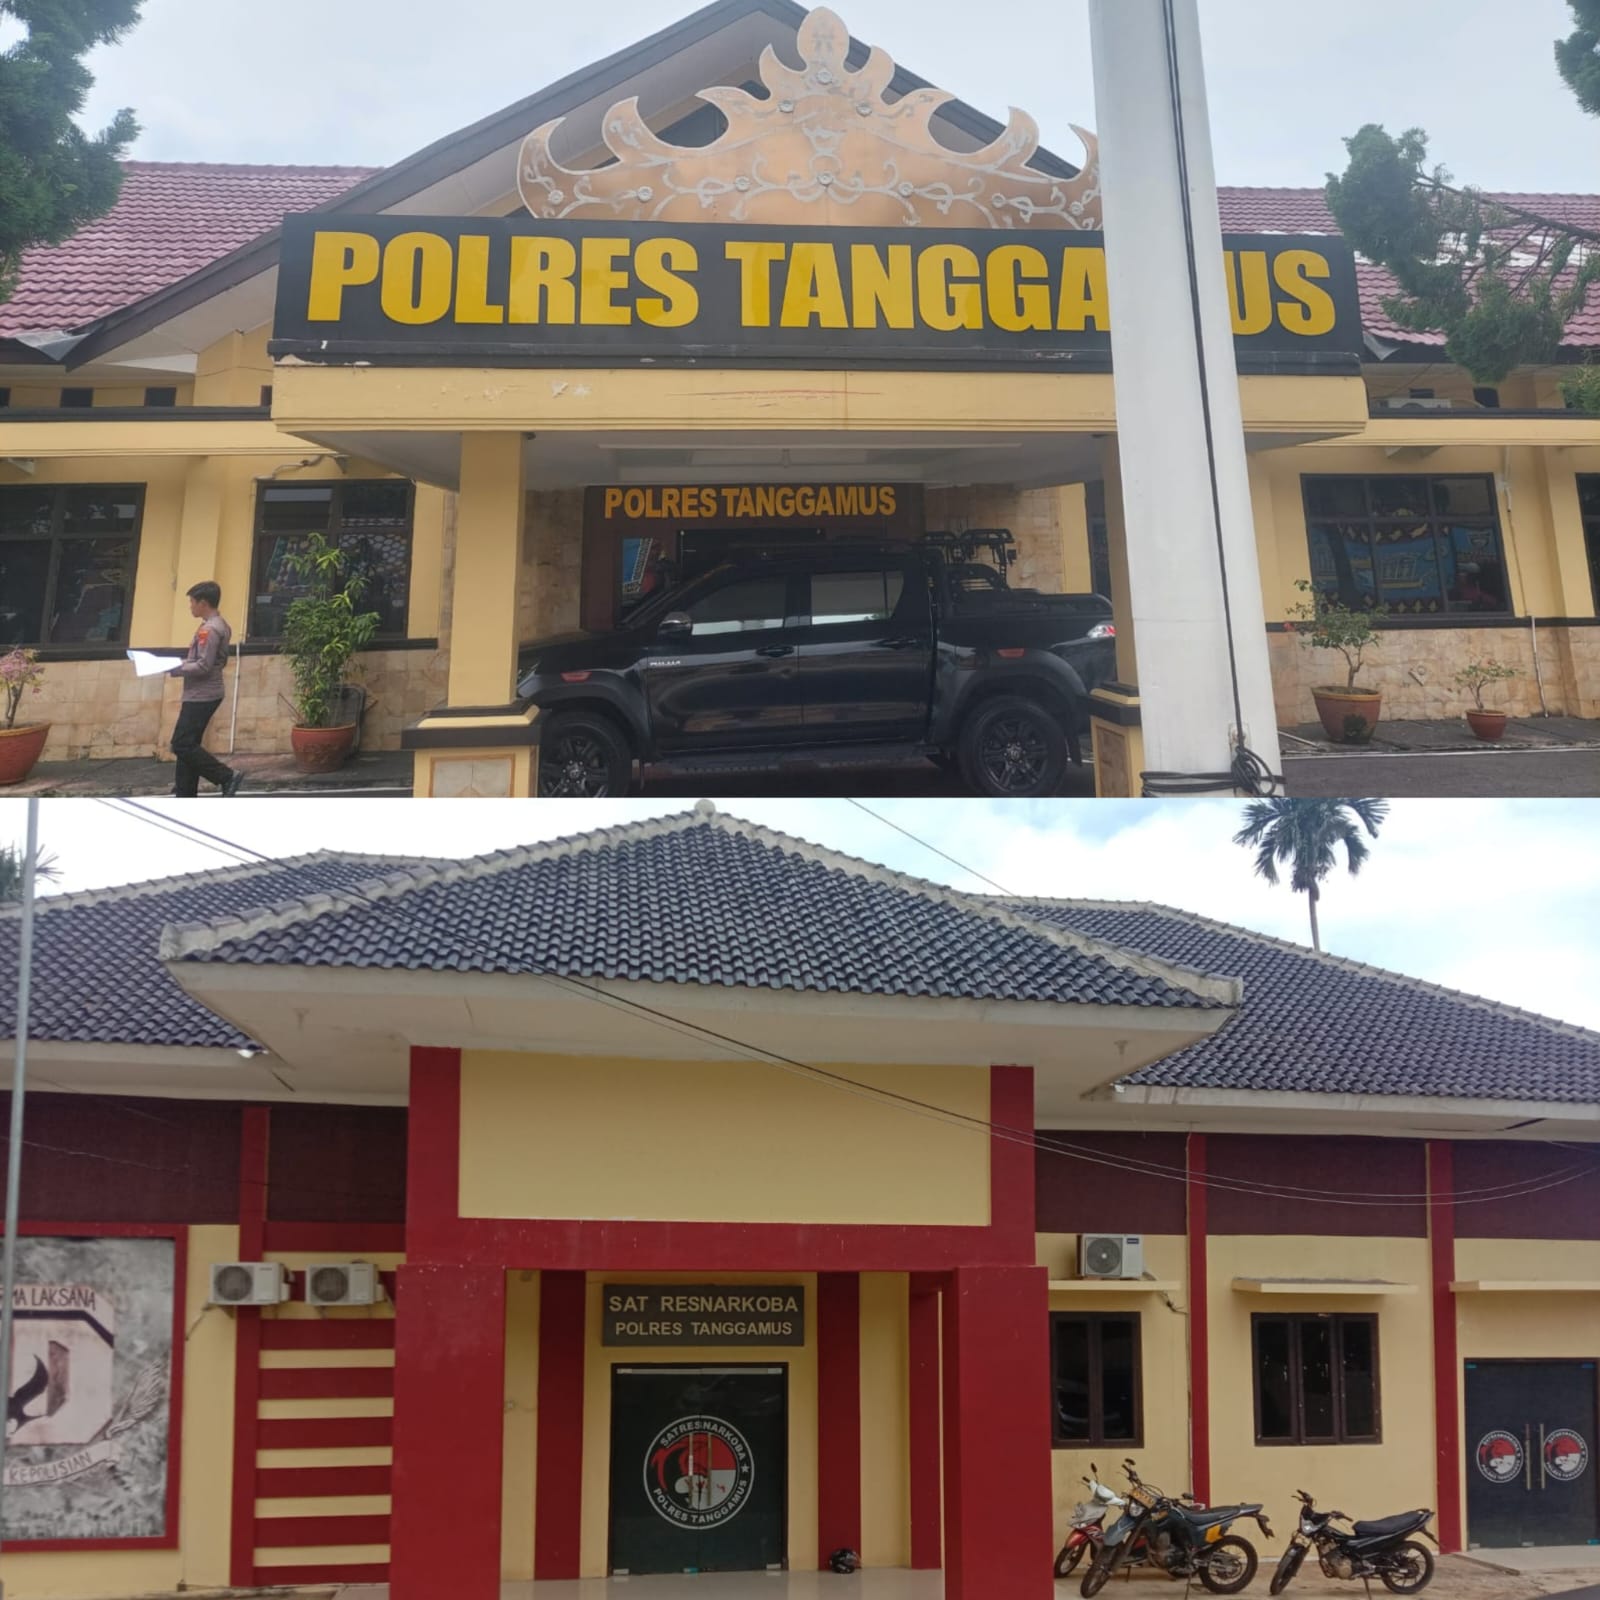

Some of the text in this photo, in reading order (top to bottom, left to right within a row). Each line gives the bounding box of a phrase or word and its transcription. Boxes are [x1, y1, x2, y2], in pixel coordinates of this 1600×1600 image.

[307, 231, 1336, 336] POLRES TANGGAUS
[604, 486, 896, 519] POLRES TANGGAMUS
[31, 1287, 97, 1312] LAKSANA
[609, 1296, 799, 1313] SAT RESNARKOBA
[615, 1322, 793, 1336] POLRES TANGGAMUS
[653, 1480, 747, 1523] POLRES TANGGAMUS
